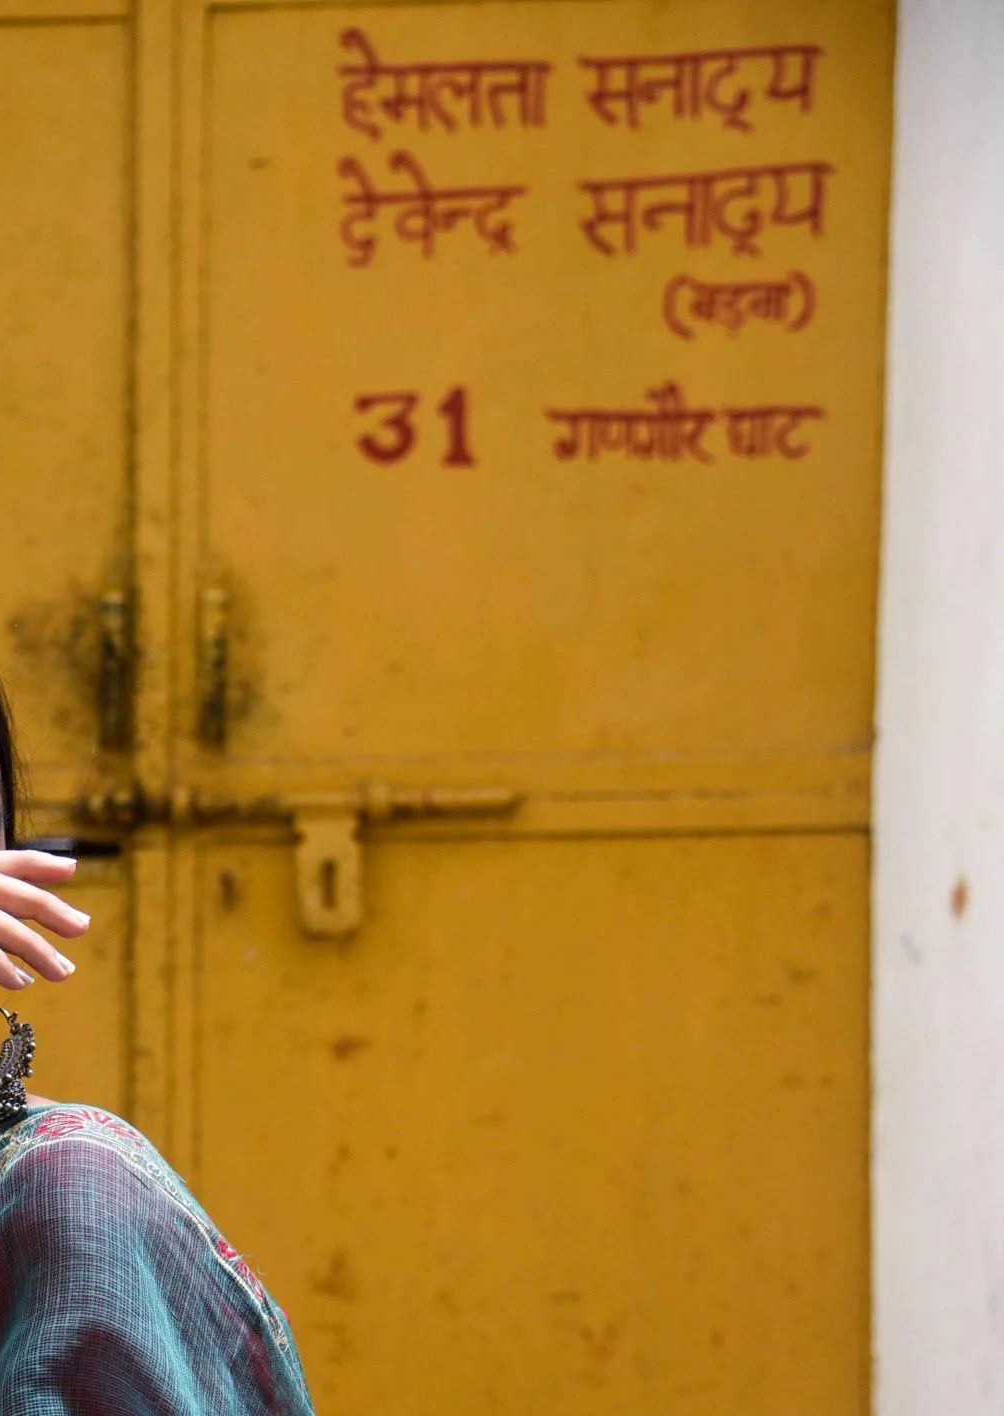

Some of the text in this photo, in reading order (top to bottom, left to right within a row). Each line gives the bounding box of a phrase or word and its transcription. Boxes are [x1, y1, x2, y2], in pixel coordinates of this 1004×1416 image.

[337, 28, 553, 140] हेमलता
[337, 151, 528, 268] देवेन्द्र
[353, 385, 477, 468] 31
[719, 406, 825, 460] घाट
